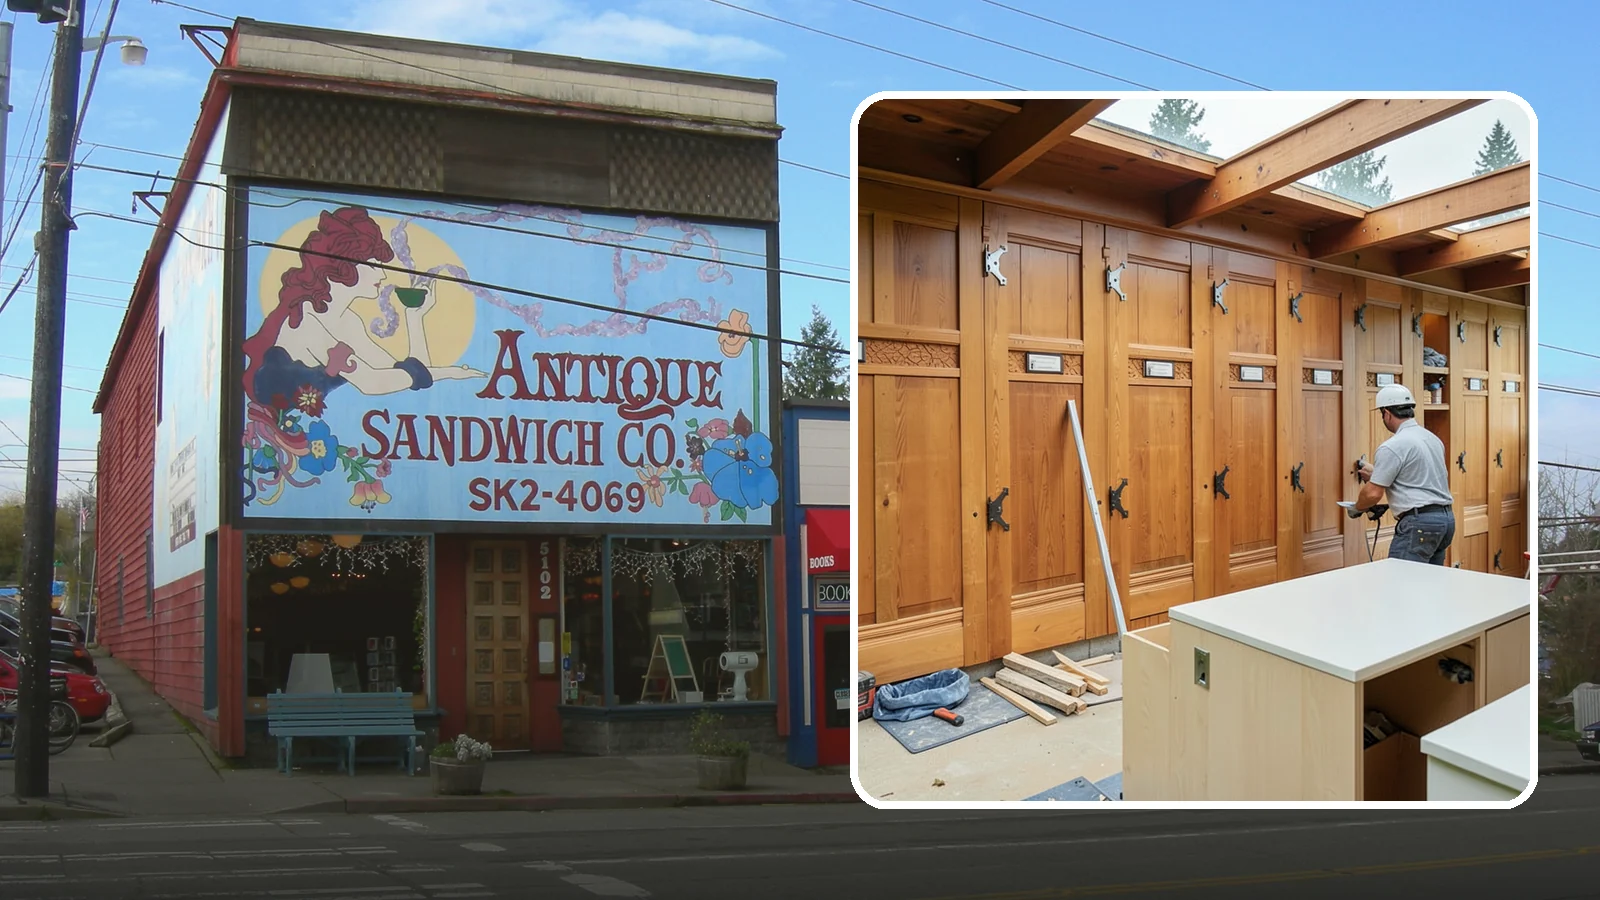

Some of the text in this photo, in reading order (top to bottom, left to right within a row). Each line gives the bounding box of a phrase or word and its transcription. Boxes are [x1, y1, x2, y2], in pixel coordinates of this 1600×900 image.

[476, 329, 724, 420] ANTIQUE
[361, 408, 685, 469] SANDWICH CO.
[468, 477, 646, 513] SK2-4069
[540, 542, 552, 600] 5102
[809, 555, 835, 569] BOOKS
